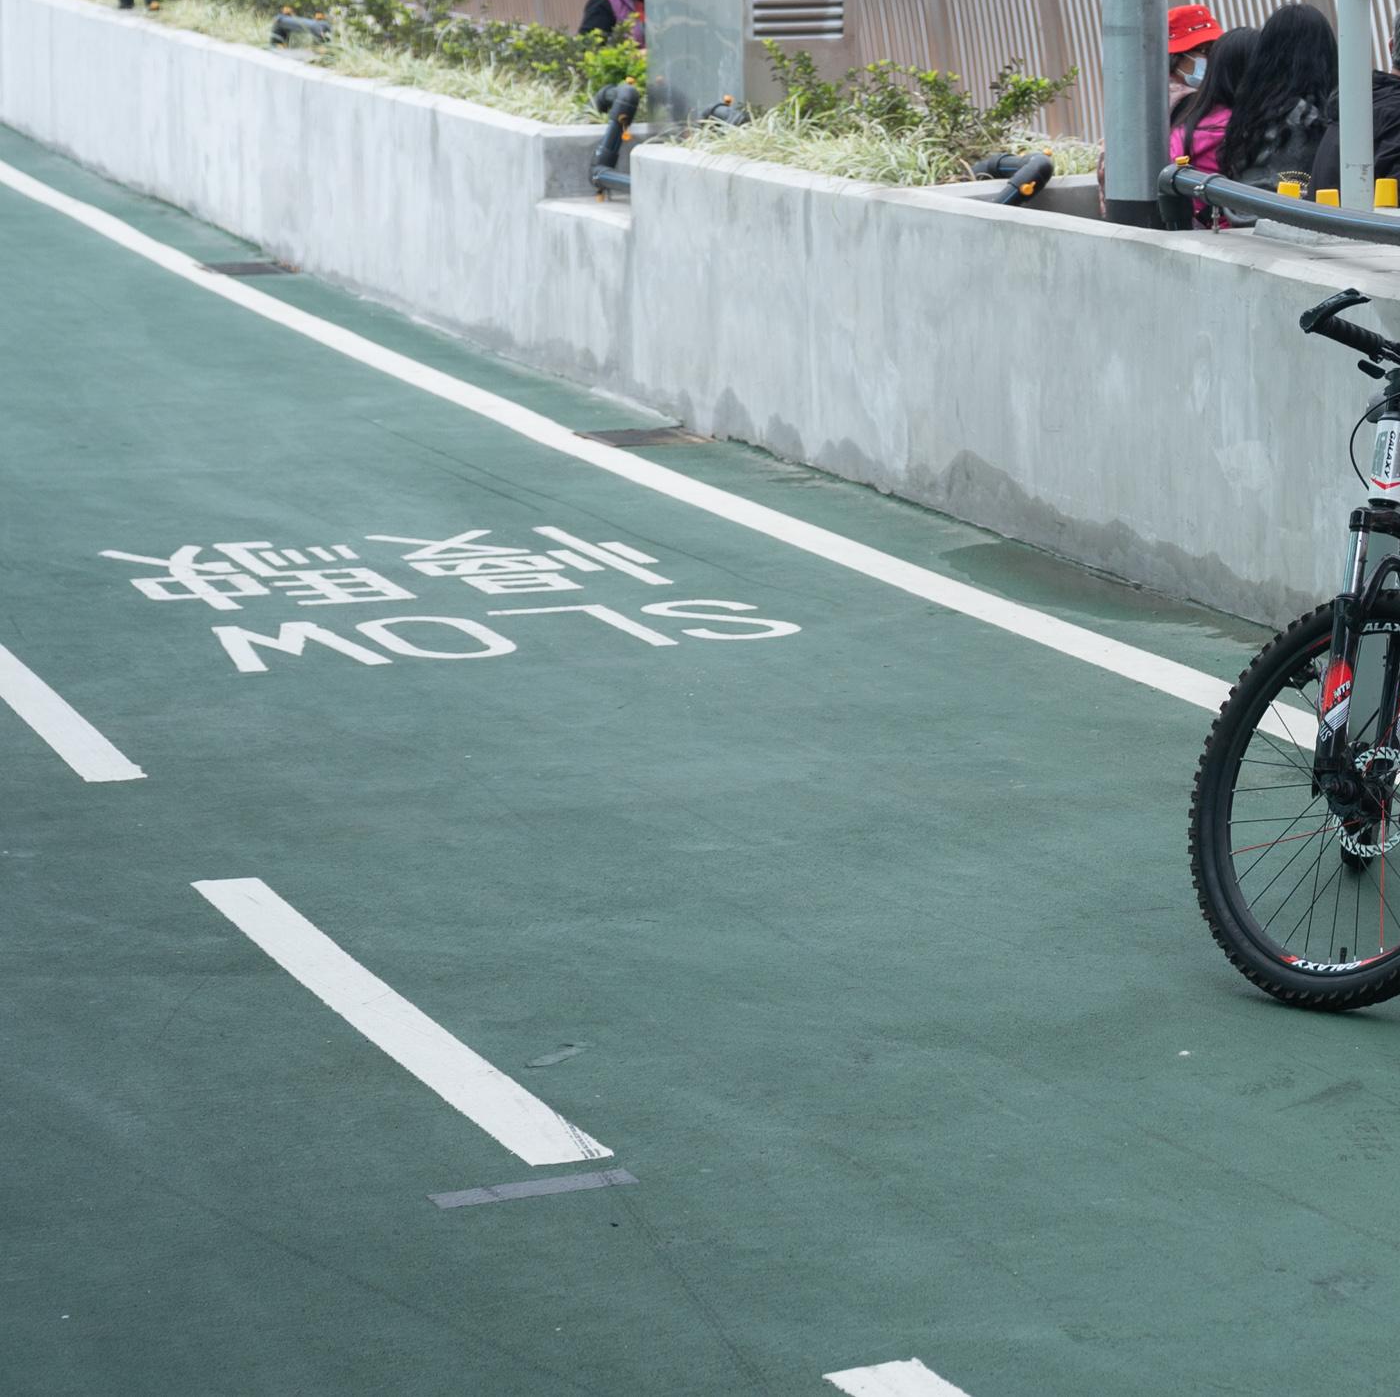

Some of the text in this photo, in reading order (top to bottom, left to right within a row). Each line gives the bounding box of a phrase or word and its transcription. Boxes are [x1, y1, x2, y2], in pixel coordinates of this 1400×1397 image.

[1385, 430, 1396, 479] GALAXY
[98, 525, 674, 611] 慢駛
[211, 598, 802, 673] SLOW
[1291, 959, 1362, 971] GALAXY
